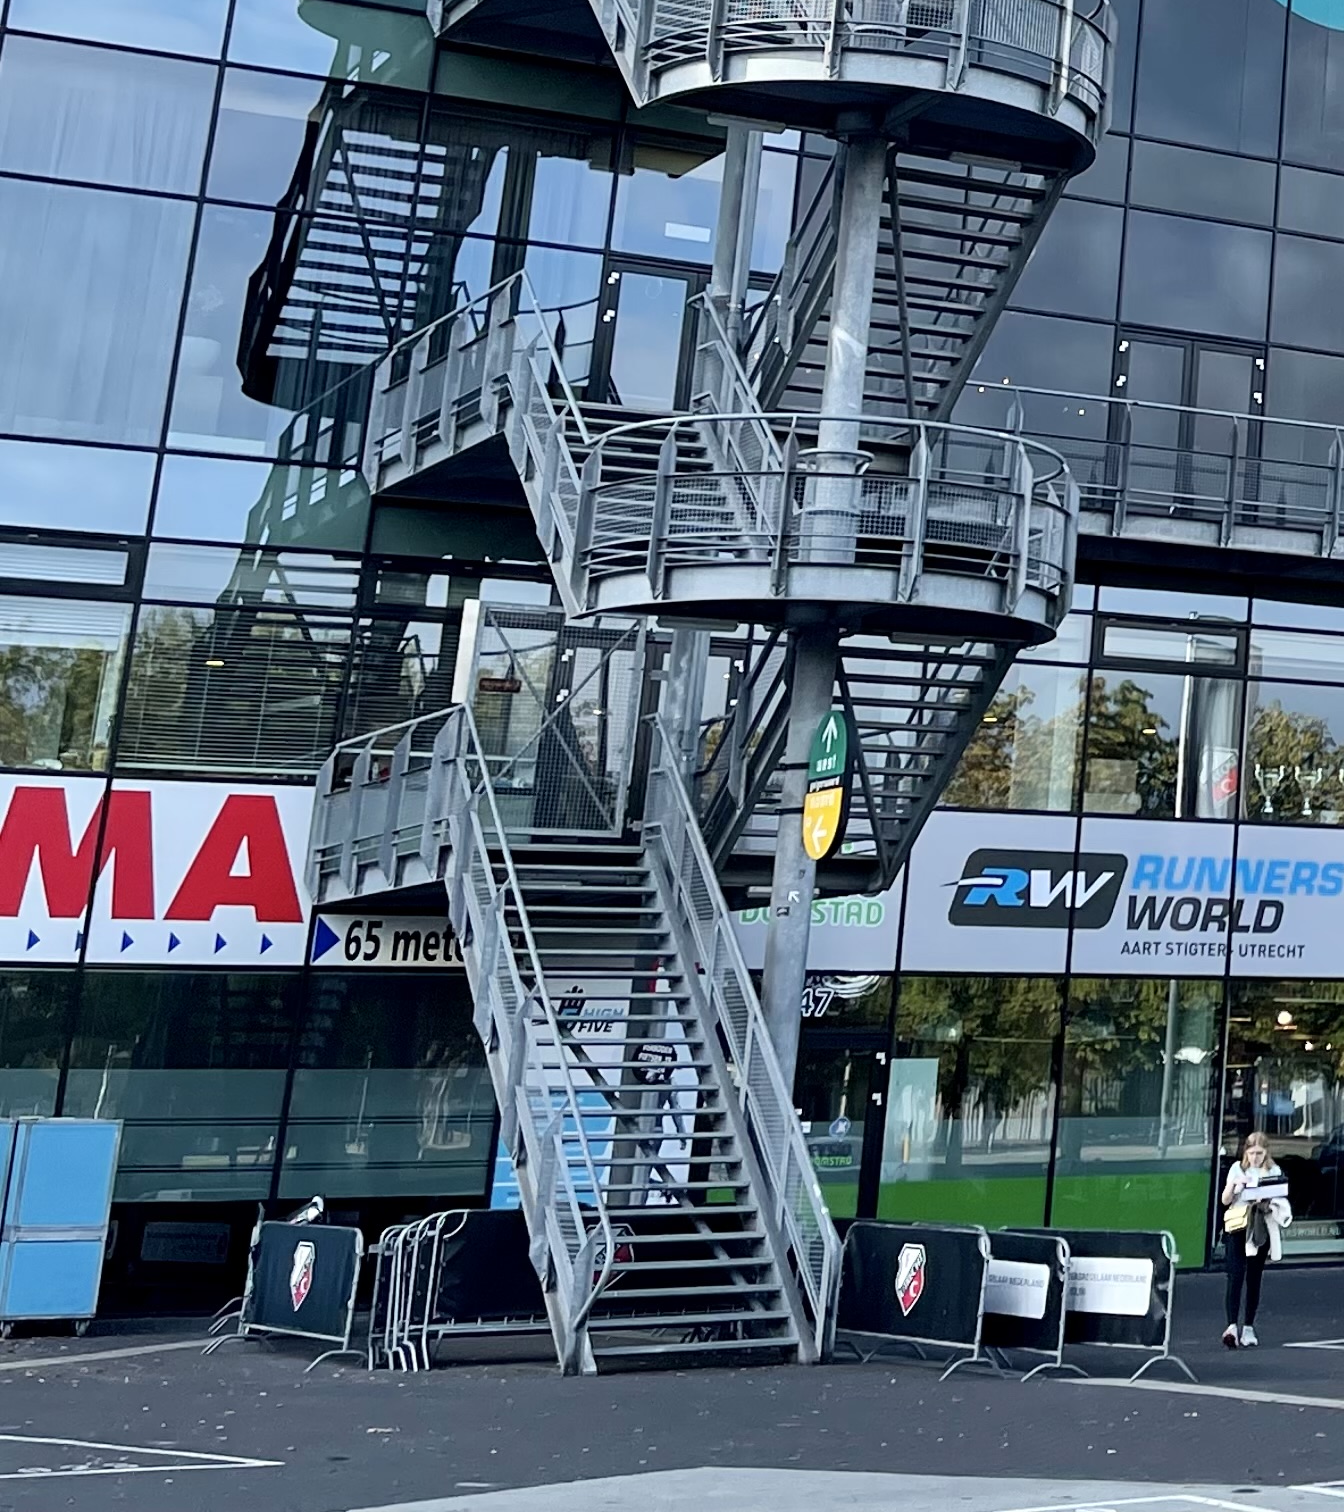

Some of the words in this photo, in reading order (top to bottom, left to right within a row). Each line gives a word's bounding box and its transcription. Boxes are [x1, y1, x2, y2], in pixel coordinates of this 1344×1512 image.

[962, 867, 1115, 908] RW
[1126, 894, 1284, 934] WORLD
[345, 920, 383, 961] 65
[1121, 941, 1161, 956] AART
[1165, 942, 1227, 958] STIGTER
[1238, 943, 1305, 959] UTRECHT
[801, 988, 834, 1017] 47
[577, 1021, 614, 1033] FIVE
